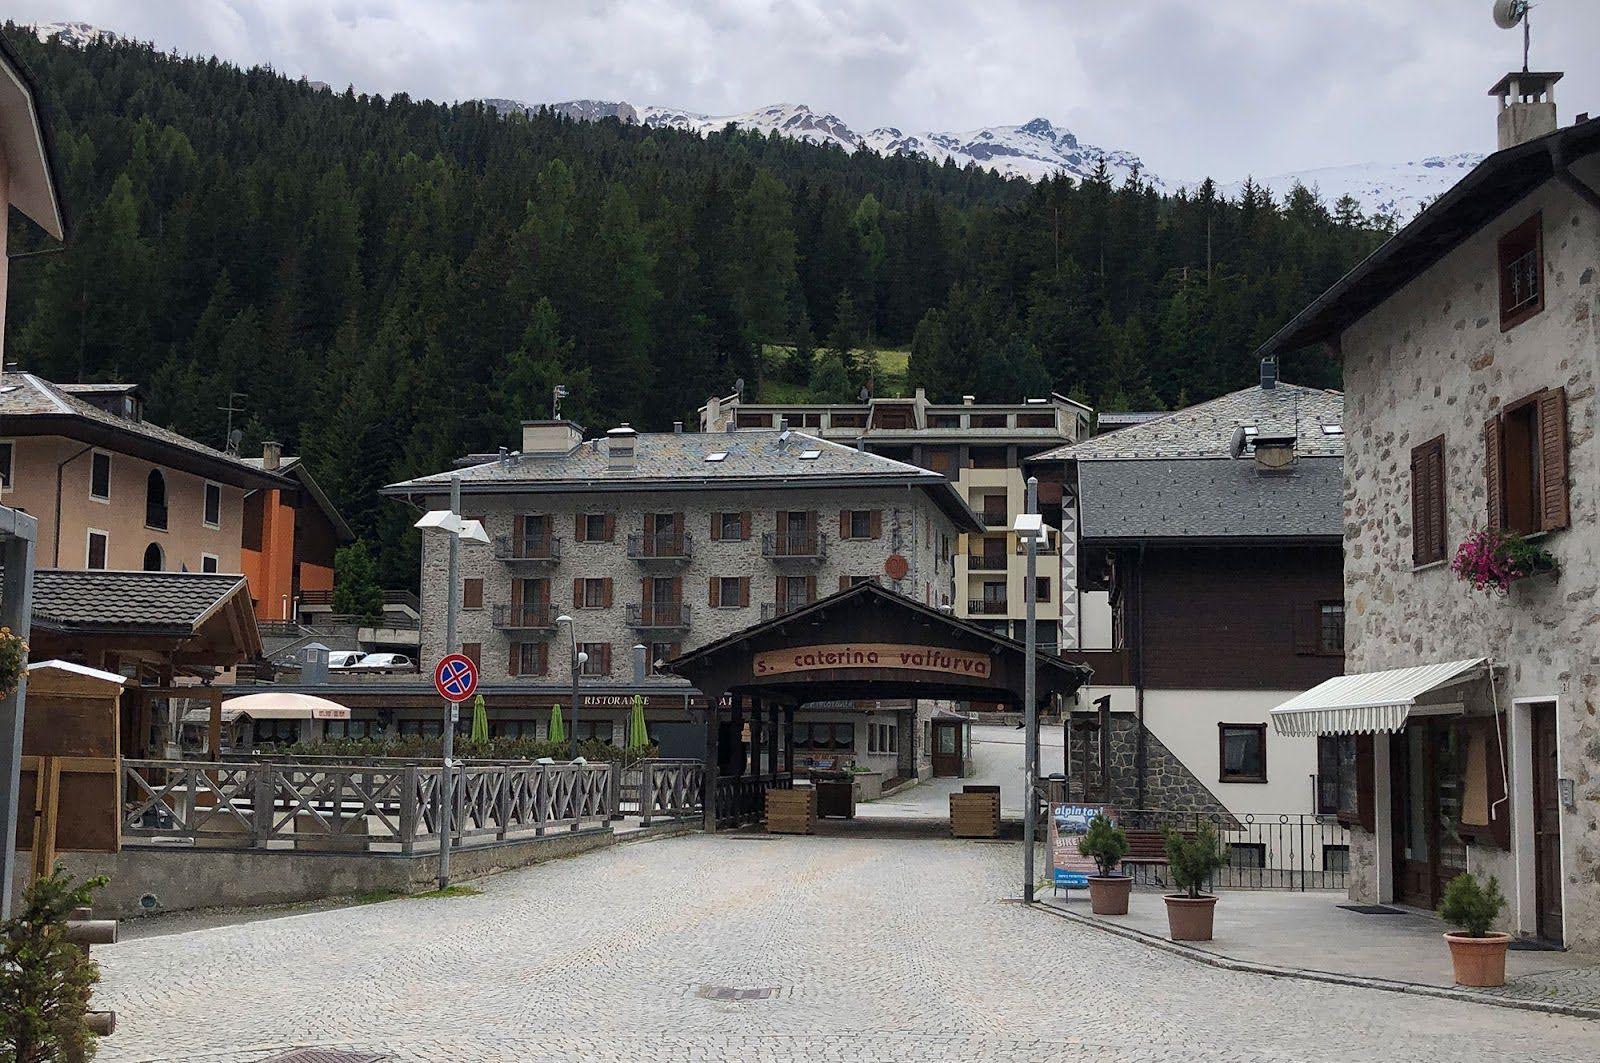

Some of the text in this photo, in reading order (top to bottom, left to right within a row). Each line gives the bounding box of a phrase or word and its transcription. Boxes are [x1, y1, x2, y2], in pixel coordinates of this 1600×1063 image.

[757, 648, 987, 675] s. caterina valfurva
[584, 696, 650, 705] RISTORANE
[1055, 805, 1104, 818] alpin taxi
